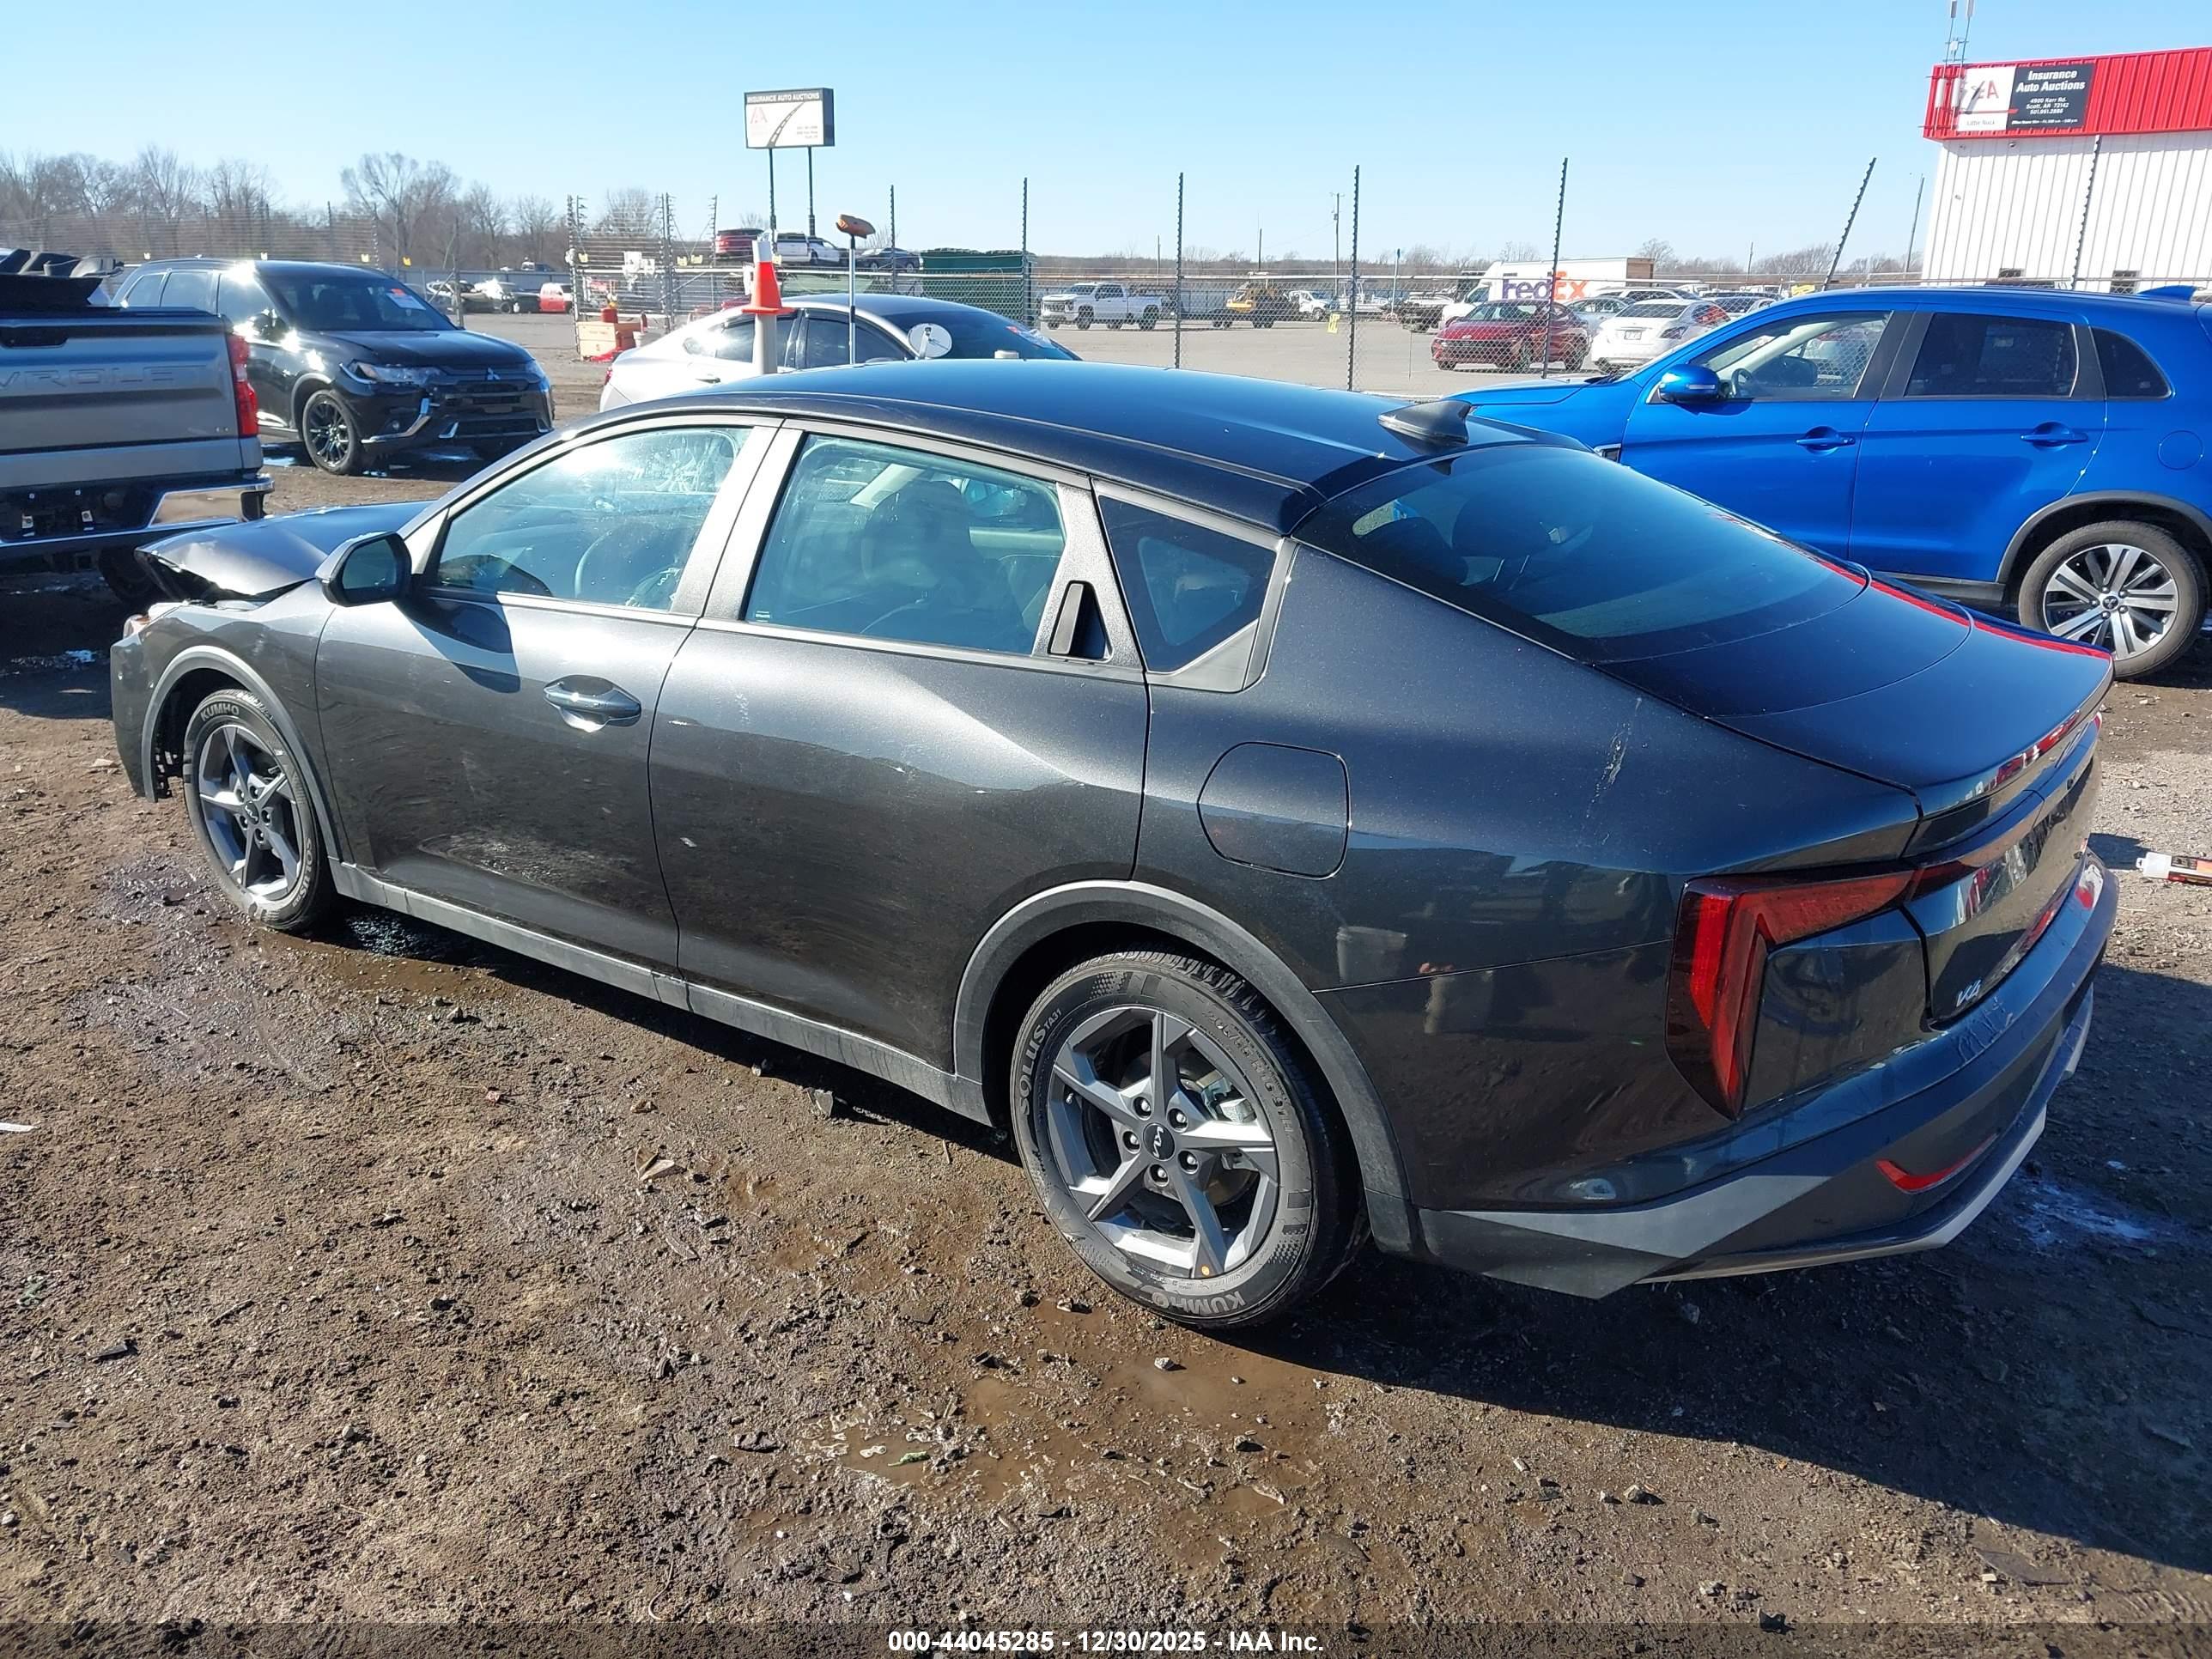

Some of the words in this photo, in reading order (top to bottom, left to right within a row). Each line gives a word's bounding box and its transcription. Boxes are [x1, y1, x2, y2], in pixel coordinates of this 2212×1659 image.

[2015, 82, 2039, 93] Auto
[2040, 80, 2086, 92] Auctions
[2028, 70, 2077, 81] Insurance
[1503, 270, 1589, 301] FedEx
[200, 702, 240, 721] KUMHO
[1018, 1024, 1047, 1116] SOLUS
[1043, 1007, 1062, 1030] TA31
[1152, 1291, 1246, 1316] KUMHO
